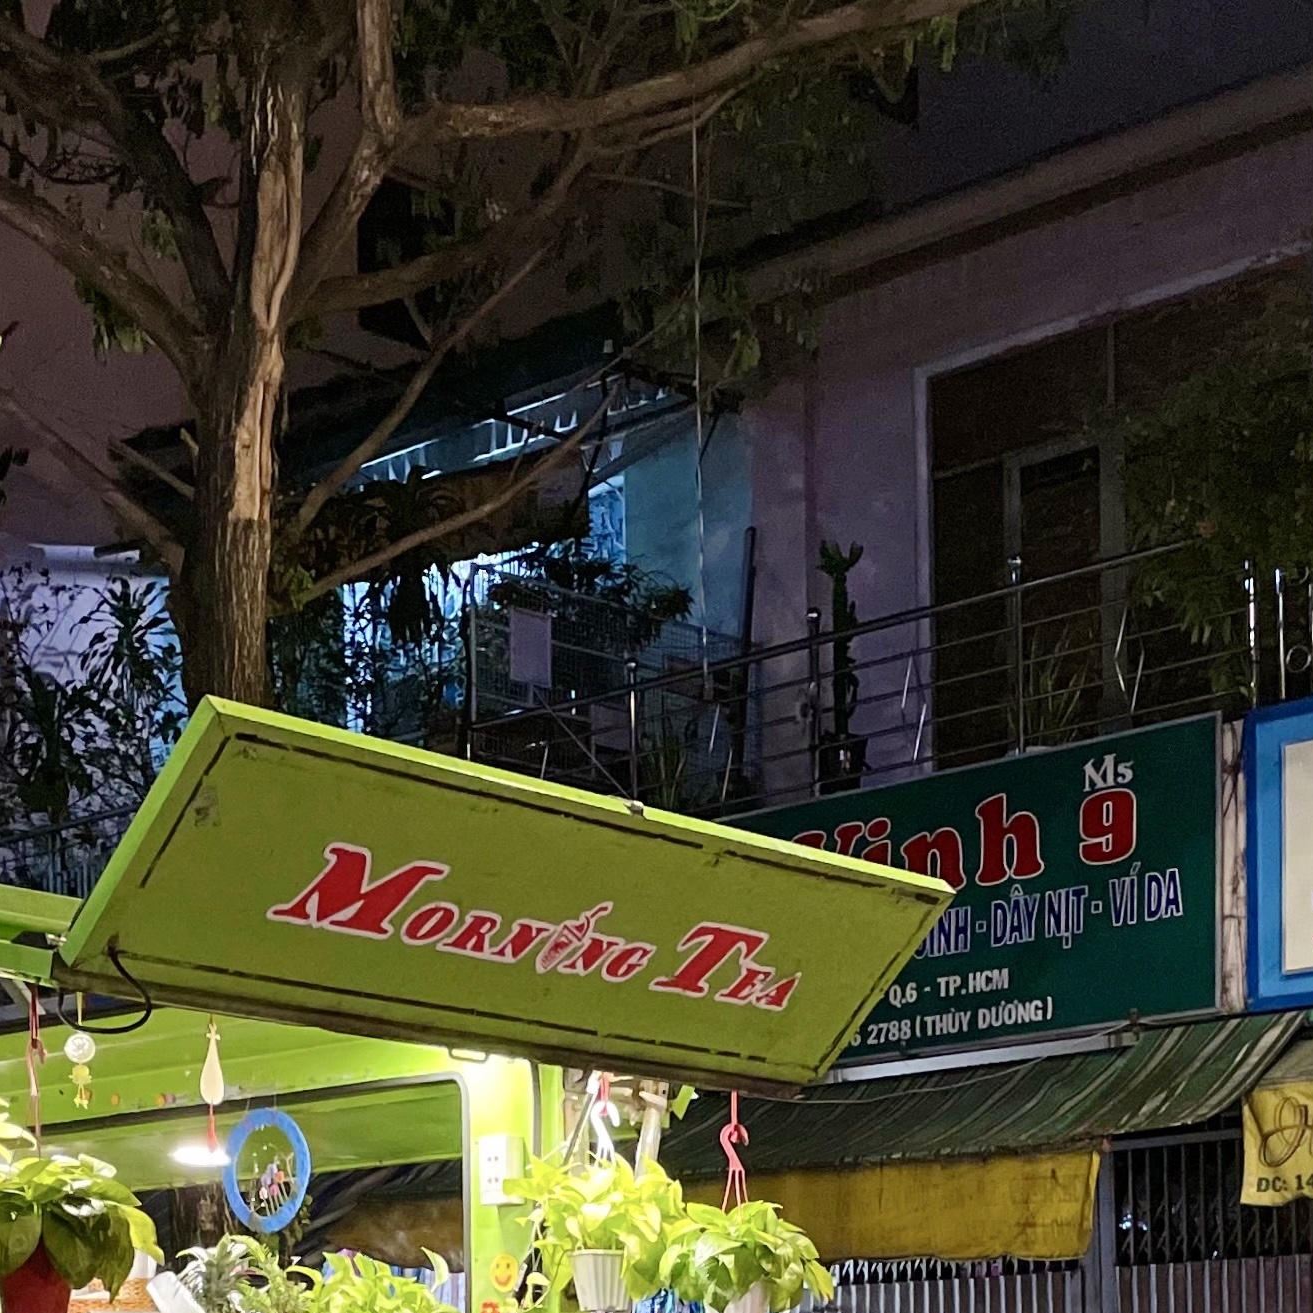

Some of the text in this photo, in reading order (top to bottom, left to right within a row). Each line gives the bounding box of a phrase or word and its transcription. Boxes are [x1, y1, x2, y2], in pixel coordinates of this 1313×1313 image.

[1082, 753, 1134, 792] Ms
[1079, 788, 1137, 865] 9
[990, 883, 1040, 947] DÂY
[1045, 885, 1089, 949] NỊT
[1108, 860, 1142, 927] VÍ
[1144, 868, 1184, 923] DA
[889, 982, 918, 1008] Q.6
[936, 967, 1009, 998] TP.HCM
[867, 1018, 912, 1045] 2788
